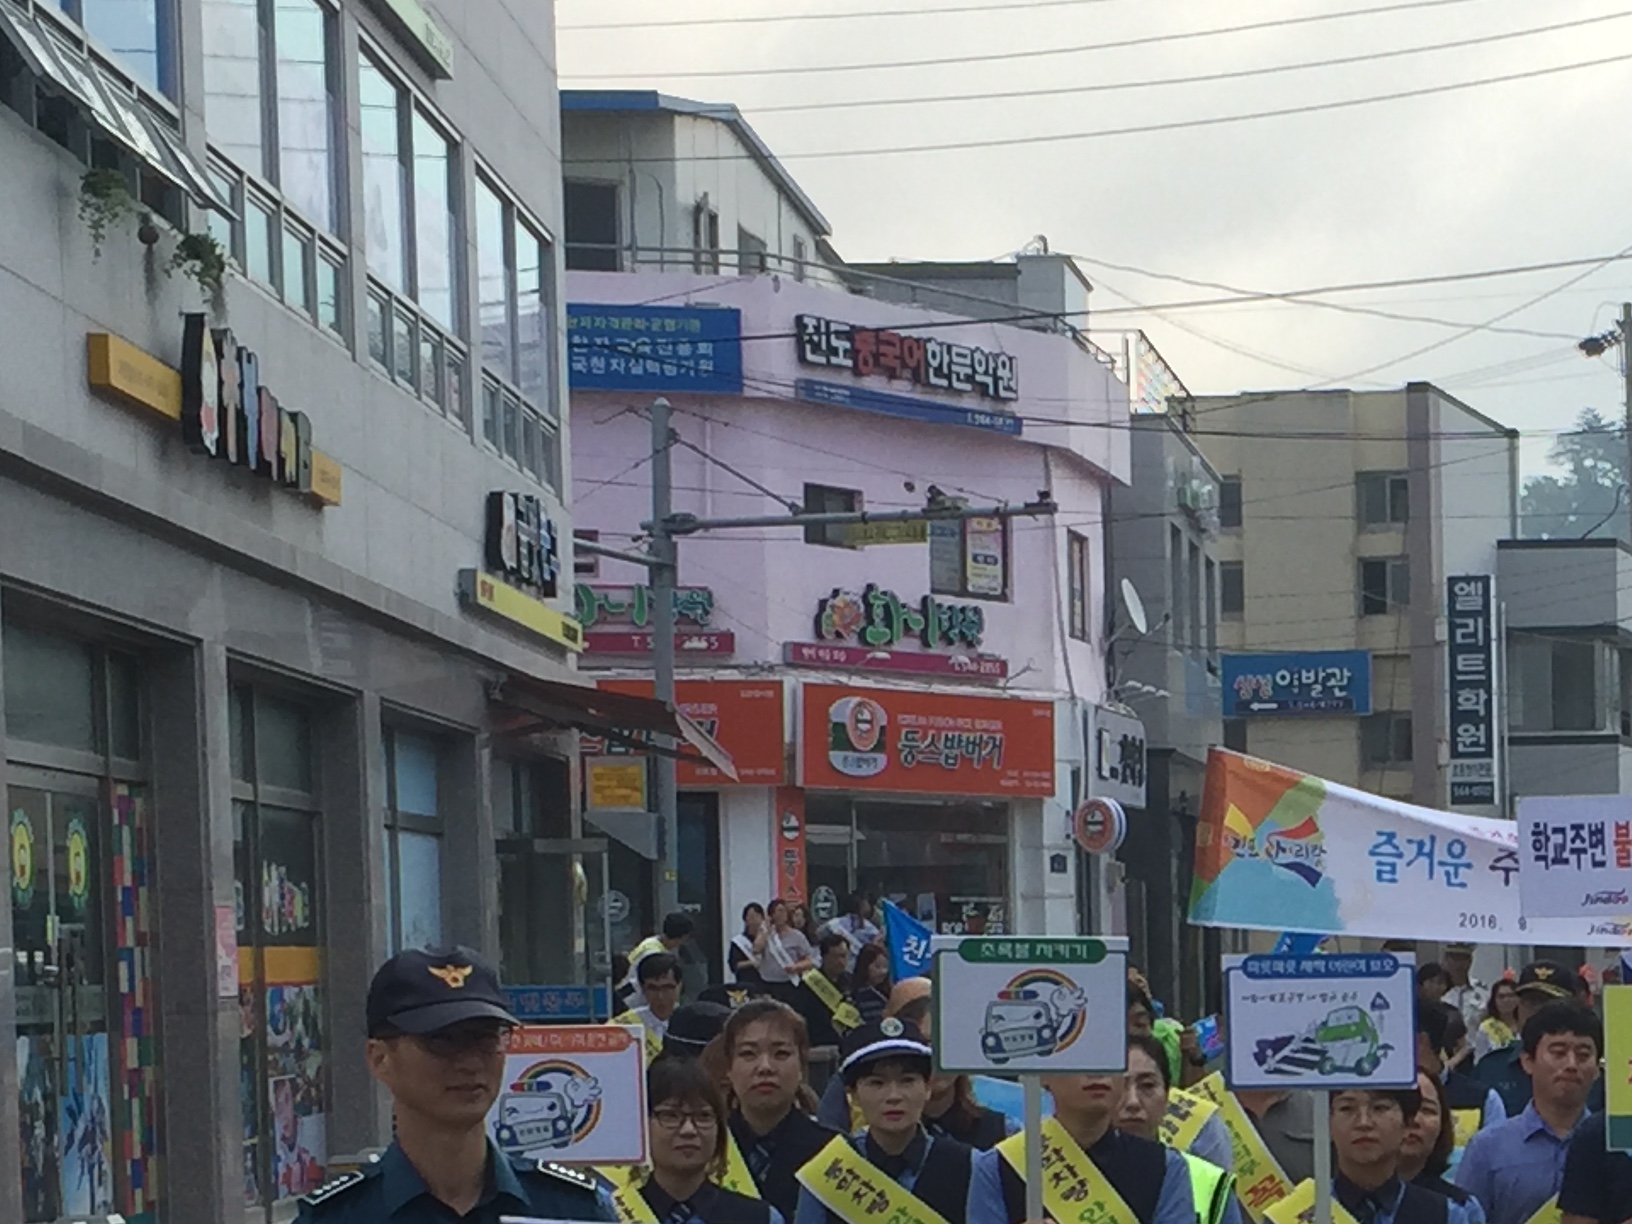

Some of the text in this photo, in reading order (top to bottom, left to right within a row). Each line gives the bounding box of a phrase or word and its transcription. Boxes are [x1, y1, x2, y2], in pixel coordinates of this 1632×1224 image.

[1454, 581, 1487, 753] 엘리트학원
[1368, 829, 1474, 888] 즐거운
[1530, 820, 1607, 870] 학교주변
